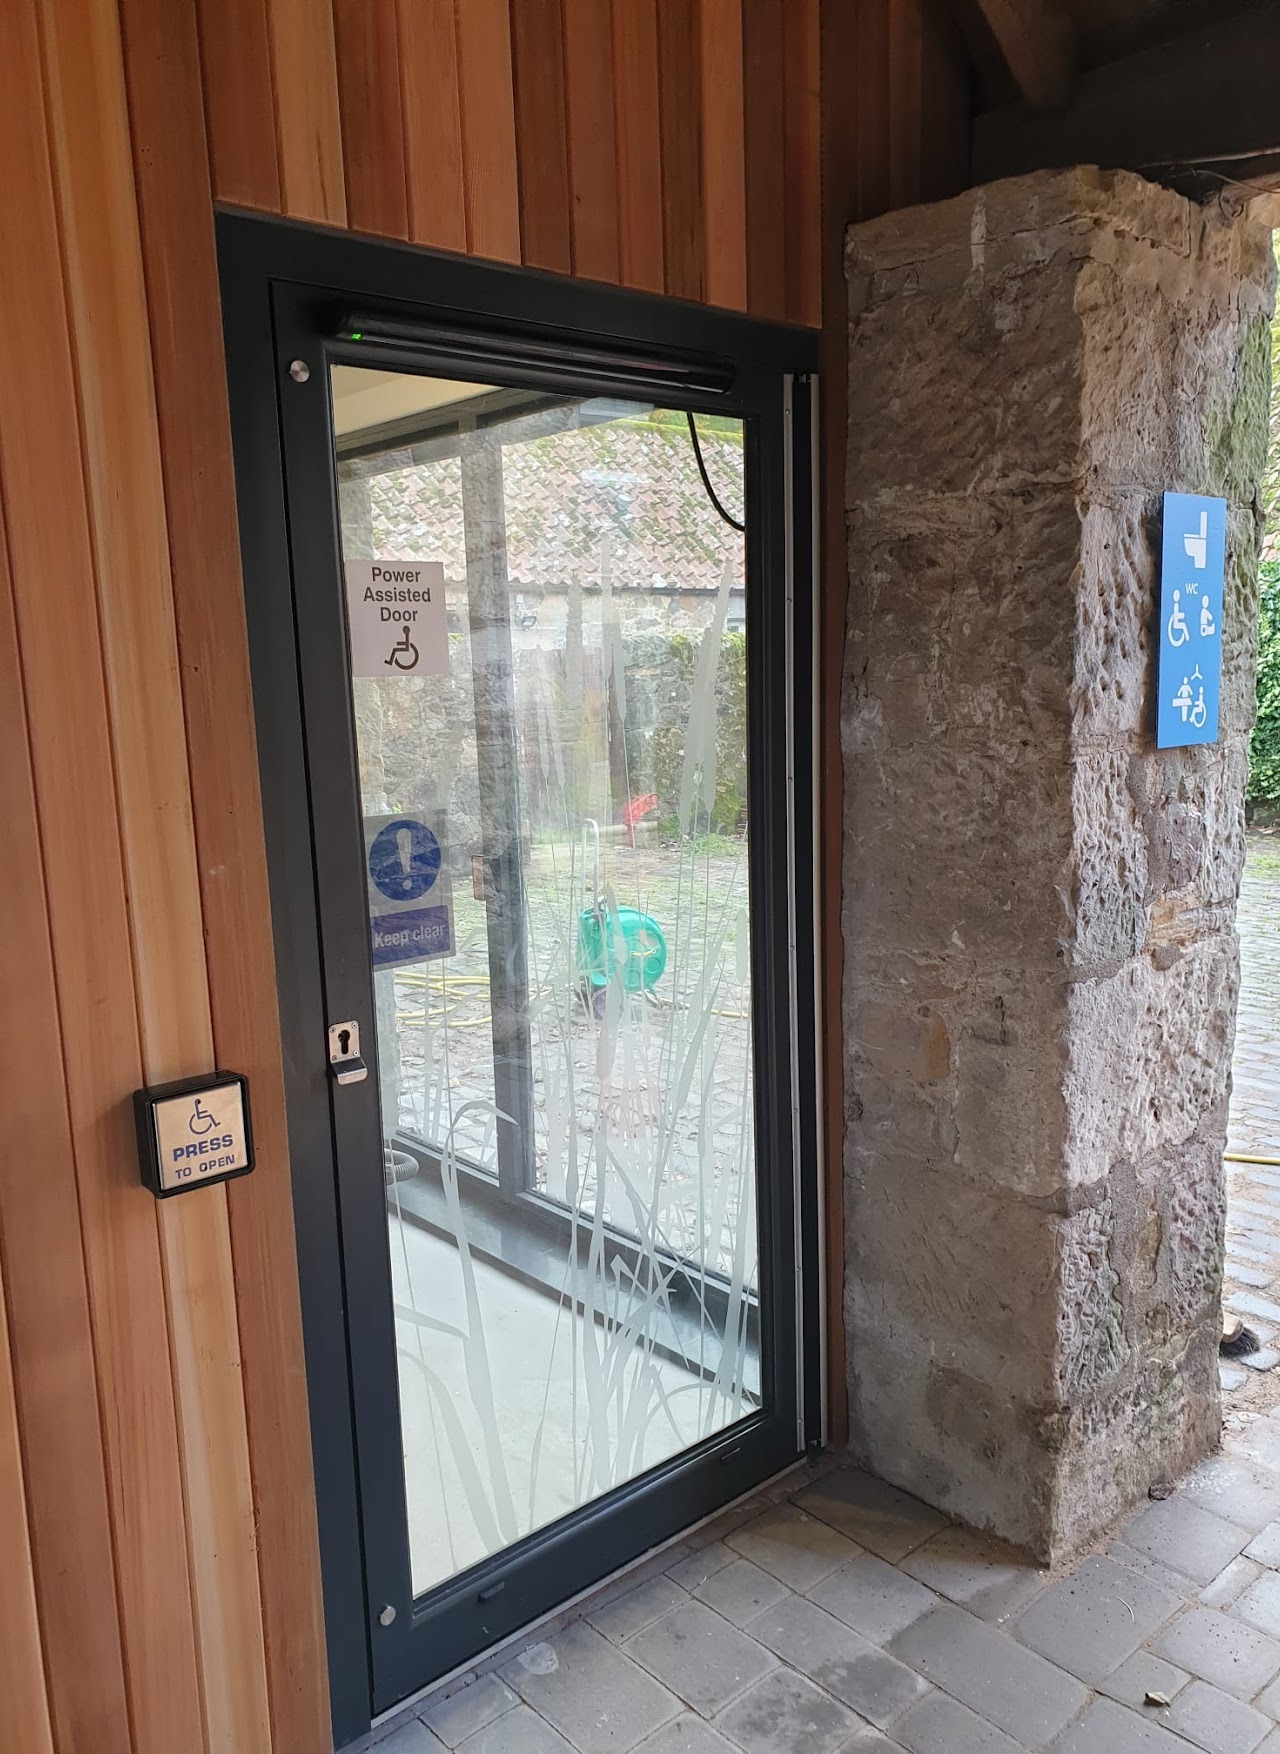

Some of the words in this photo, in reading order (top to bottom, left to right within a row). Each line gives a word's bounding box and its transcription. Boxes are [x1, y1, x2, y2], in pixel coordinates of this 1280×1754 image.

[371, 566, 421, 582] Power
[363, 586, 431, 603] Assisted
[1185, 582, 1199, 595] WC
[380, 606, 418, 622] Door
[374, 929, 410, 948] Keep
[413, 923, 446, 941] clear
[172, 1133, 234, 1162] PRESS
[175, 1166, 192, 1179] TO
[199, 1154, 235, 1172] OPEN
